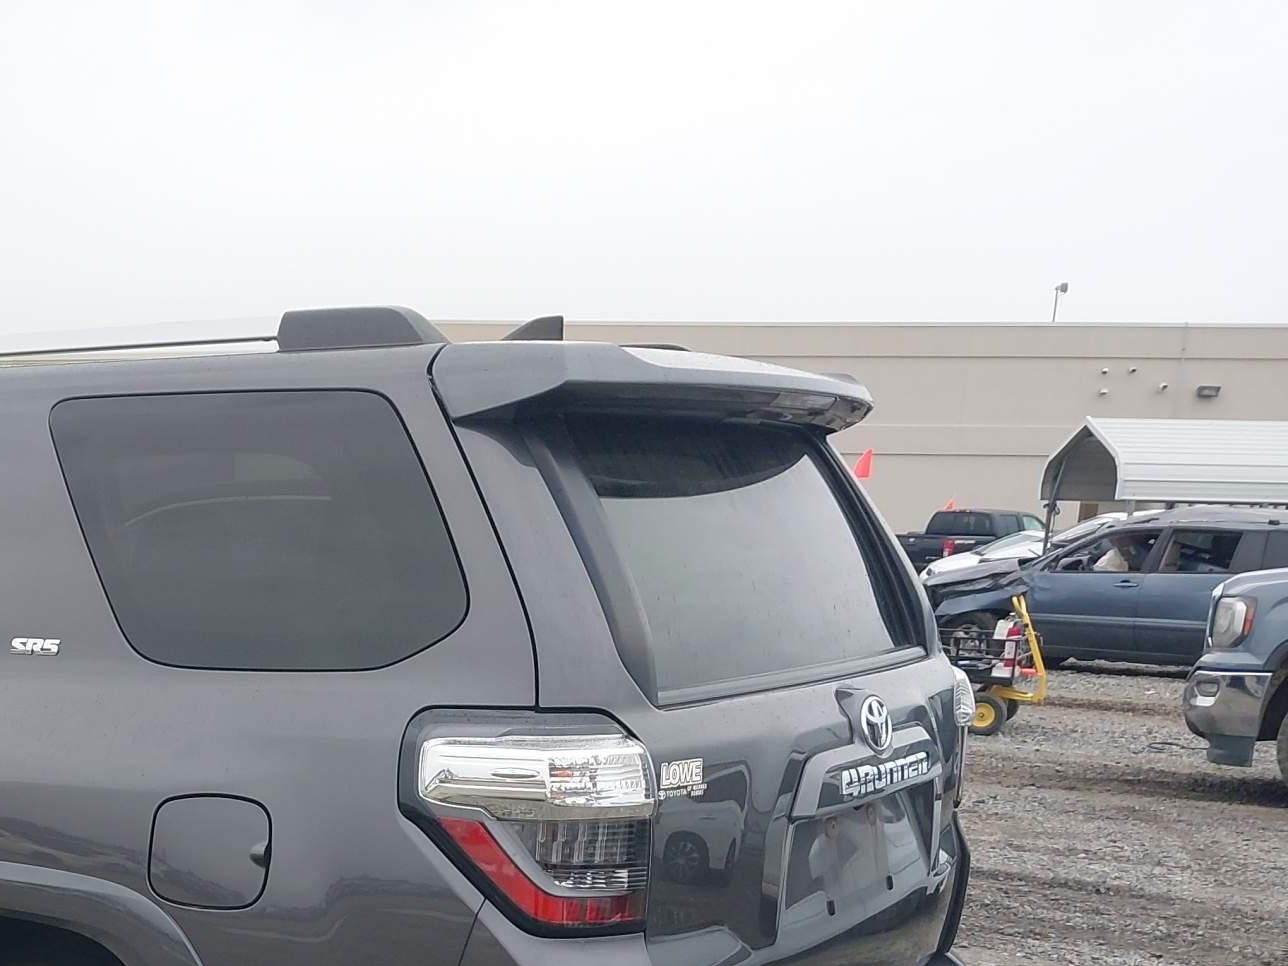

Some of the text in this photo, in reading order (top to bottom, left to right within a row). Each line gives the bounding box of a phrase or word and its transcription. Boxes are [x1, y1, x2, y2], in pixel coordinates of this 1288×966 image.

[9, 637, 61, 656] SR5
[660, 759, 703, 788] LOWE
[666, 788, 688, 797] TOYOTA
